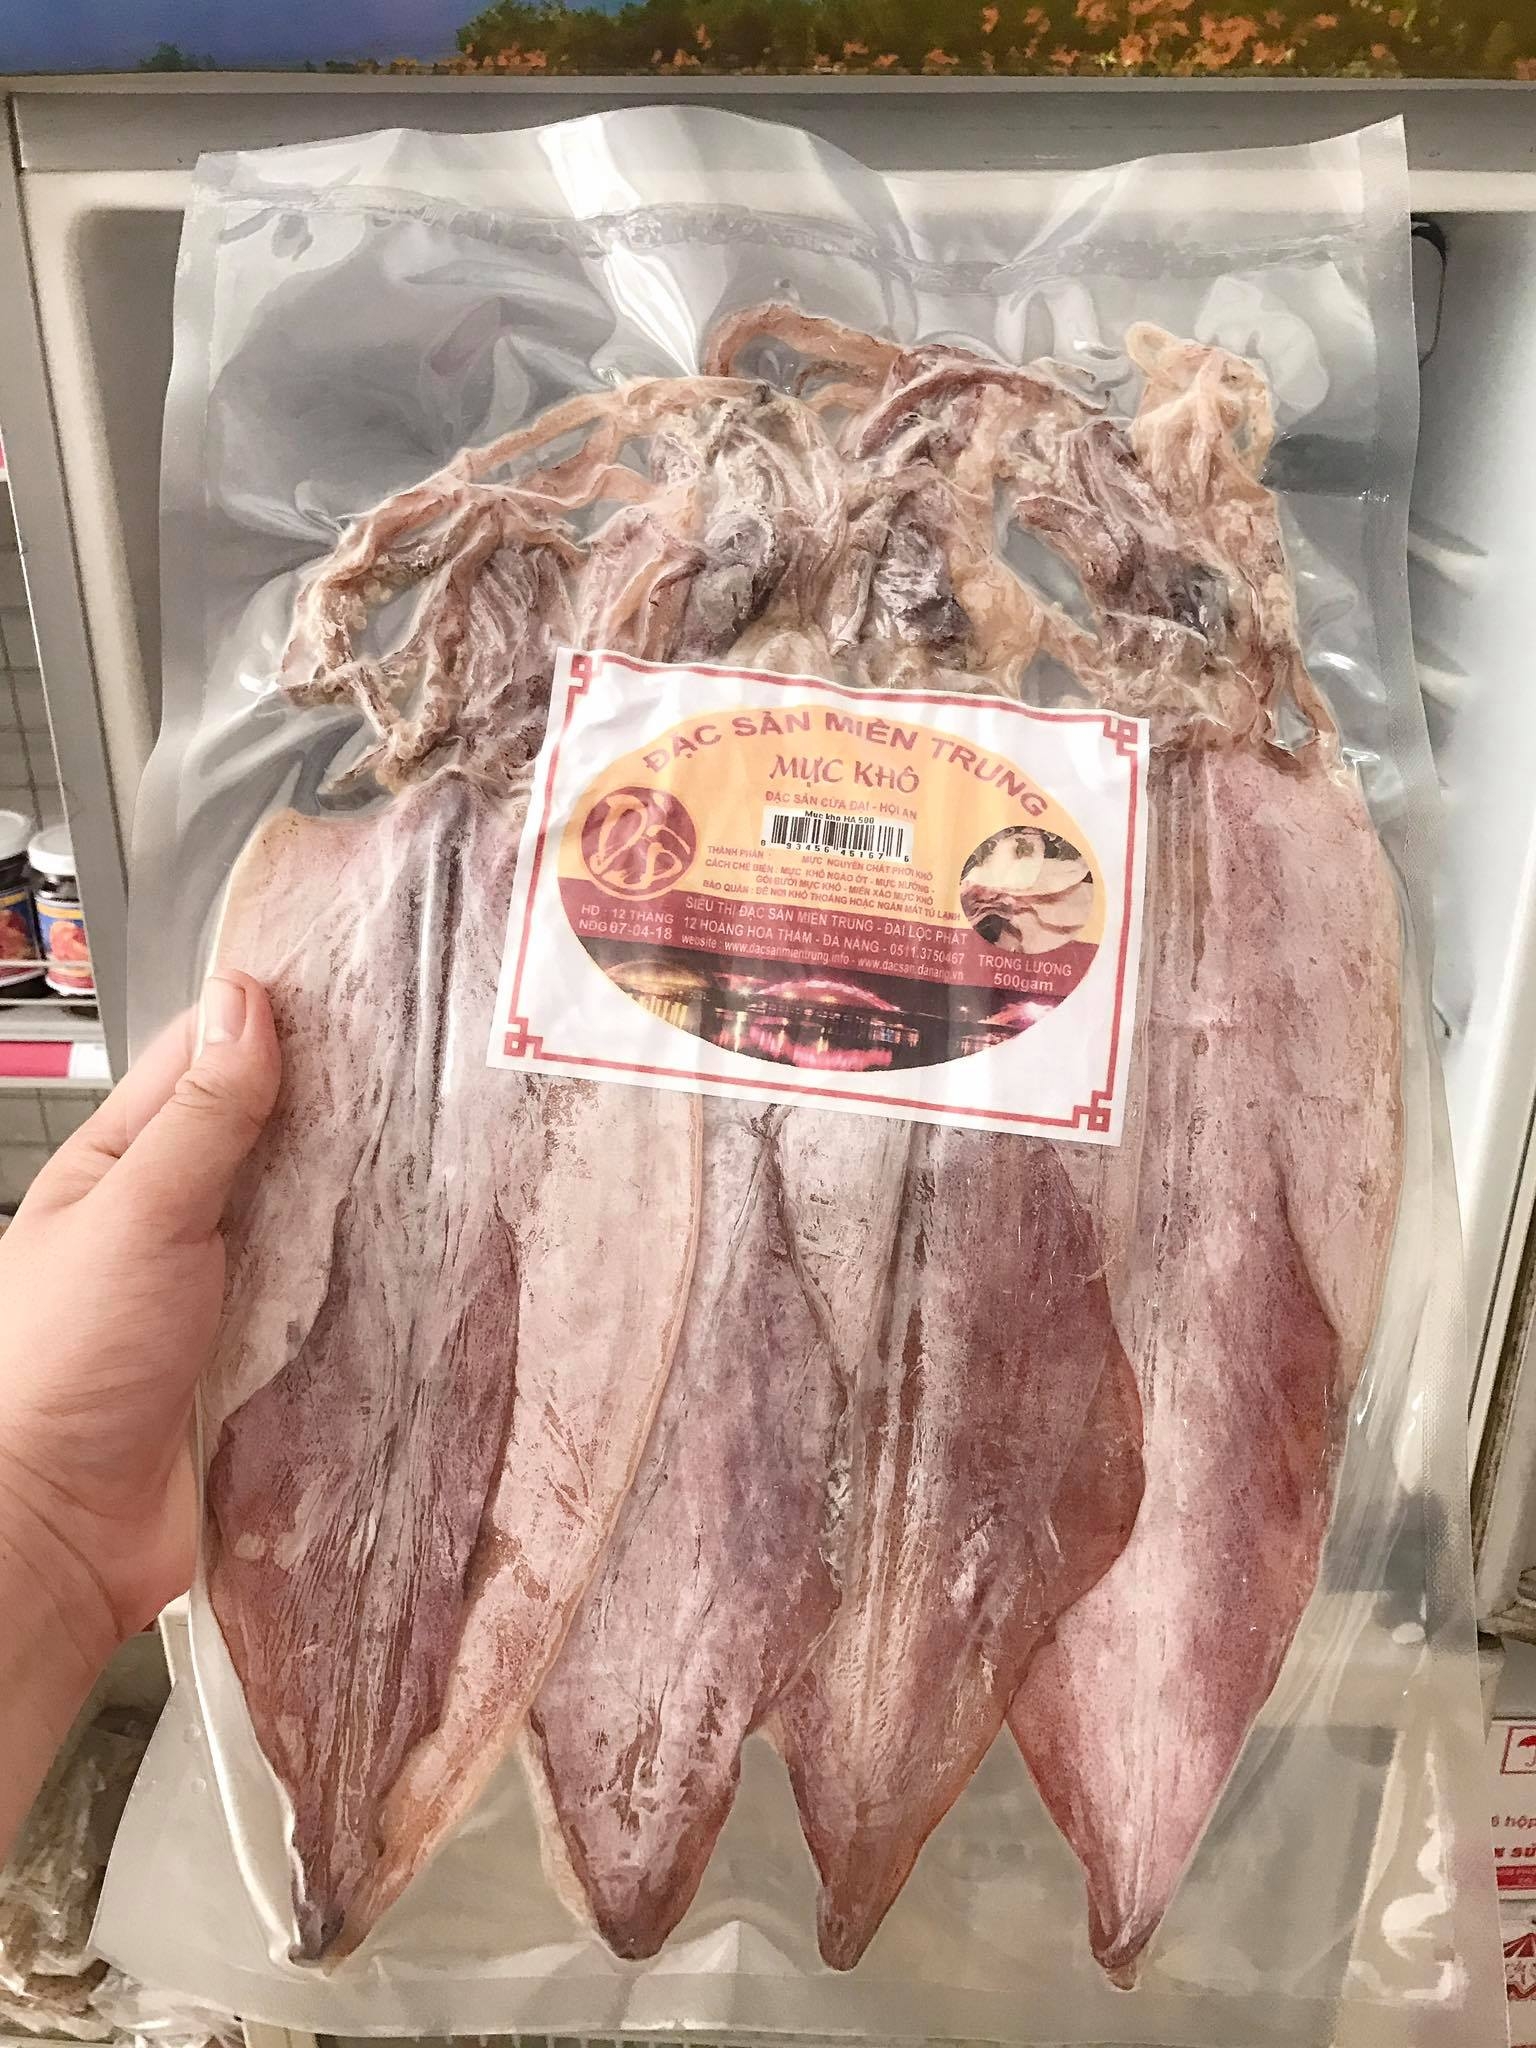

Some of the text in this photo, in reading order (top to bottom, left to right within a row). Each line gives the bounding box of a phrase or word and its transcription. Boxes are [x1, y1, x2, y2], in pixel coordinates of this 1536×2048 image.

[769, 754, 920, 793] MỰC KHÔ
[931, 737, 1048, 817] TRUNG
[825, 813, 841, 822] kho
[843, 816, 857, 824] HA
[858, 817, 875, 825] 500
[902, 809, 918, 820] AN
[613, 908, 626, 919] 12
[609, 921, 673, 940] 07-04-18
[684, 916, 698, 930] 12
[746, 925, 774, 939] HOA
[831, 914, 874, 932] TRUNG
[681, 934, 717, 949] website
[994, 973, 1054, 992] 500gam
